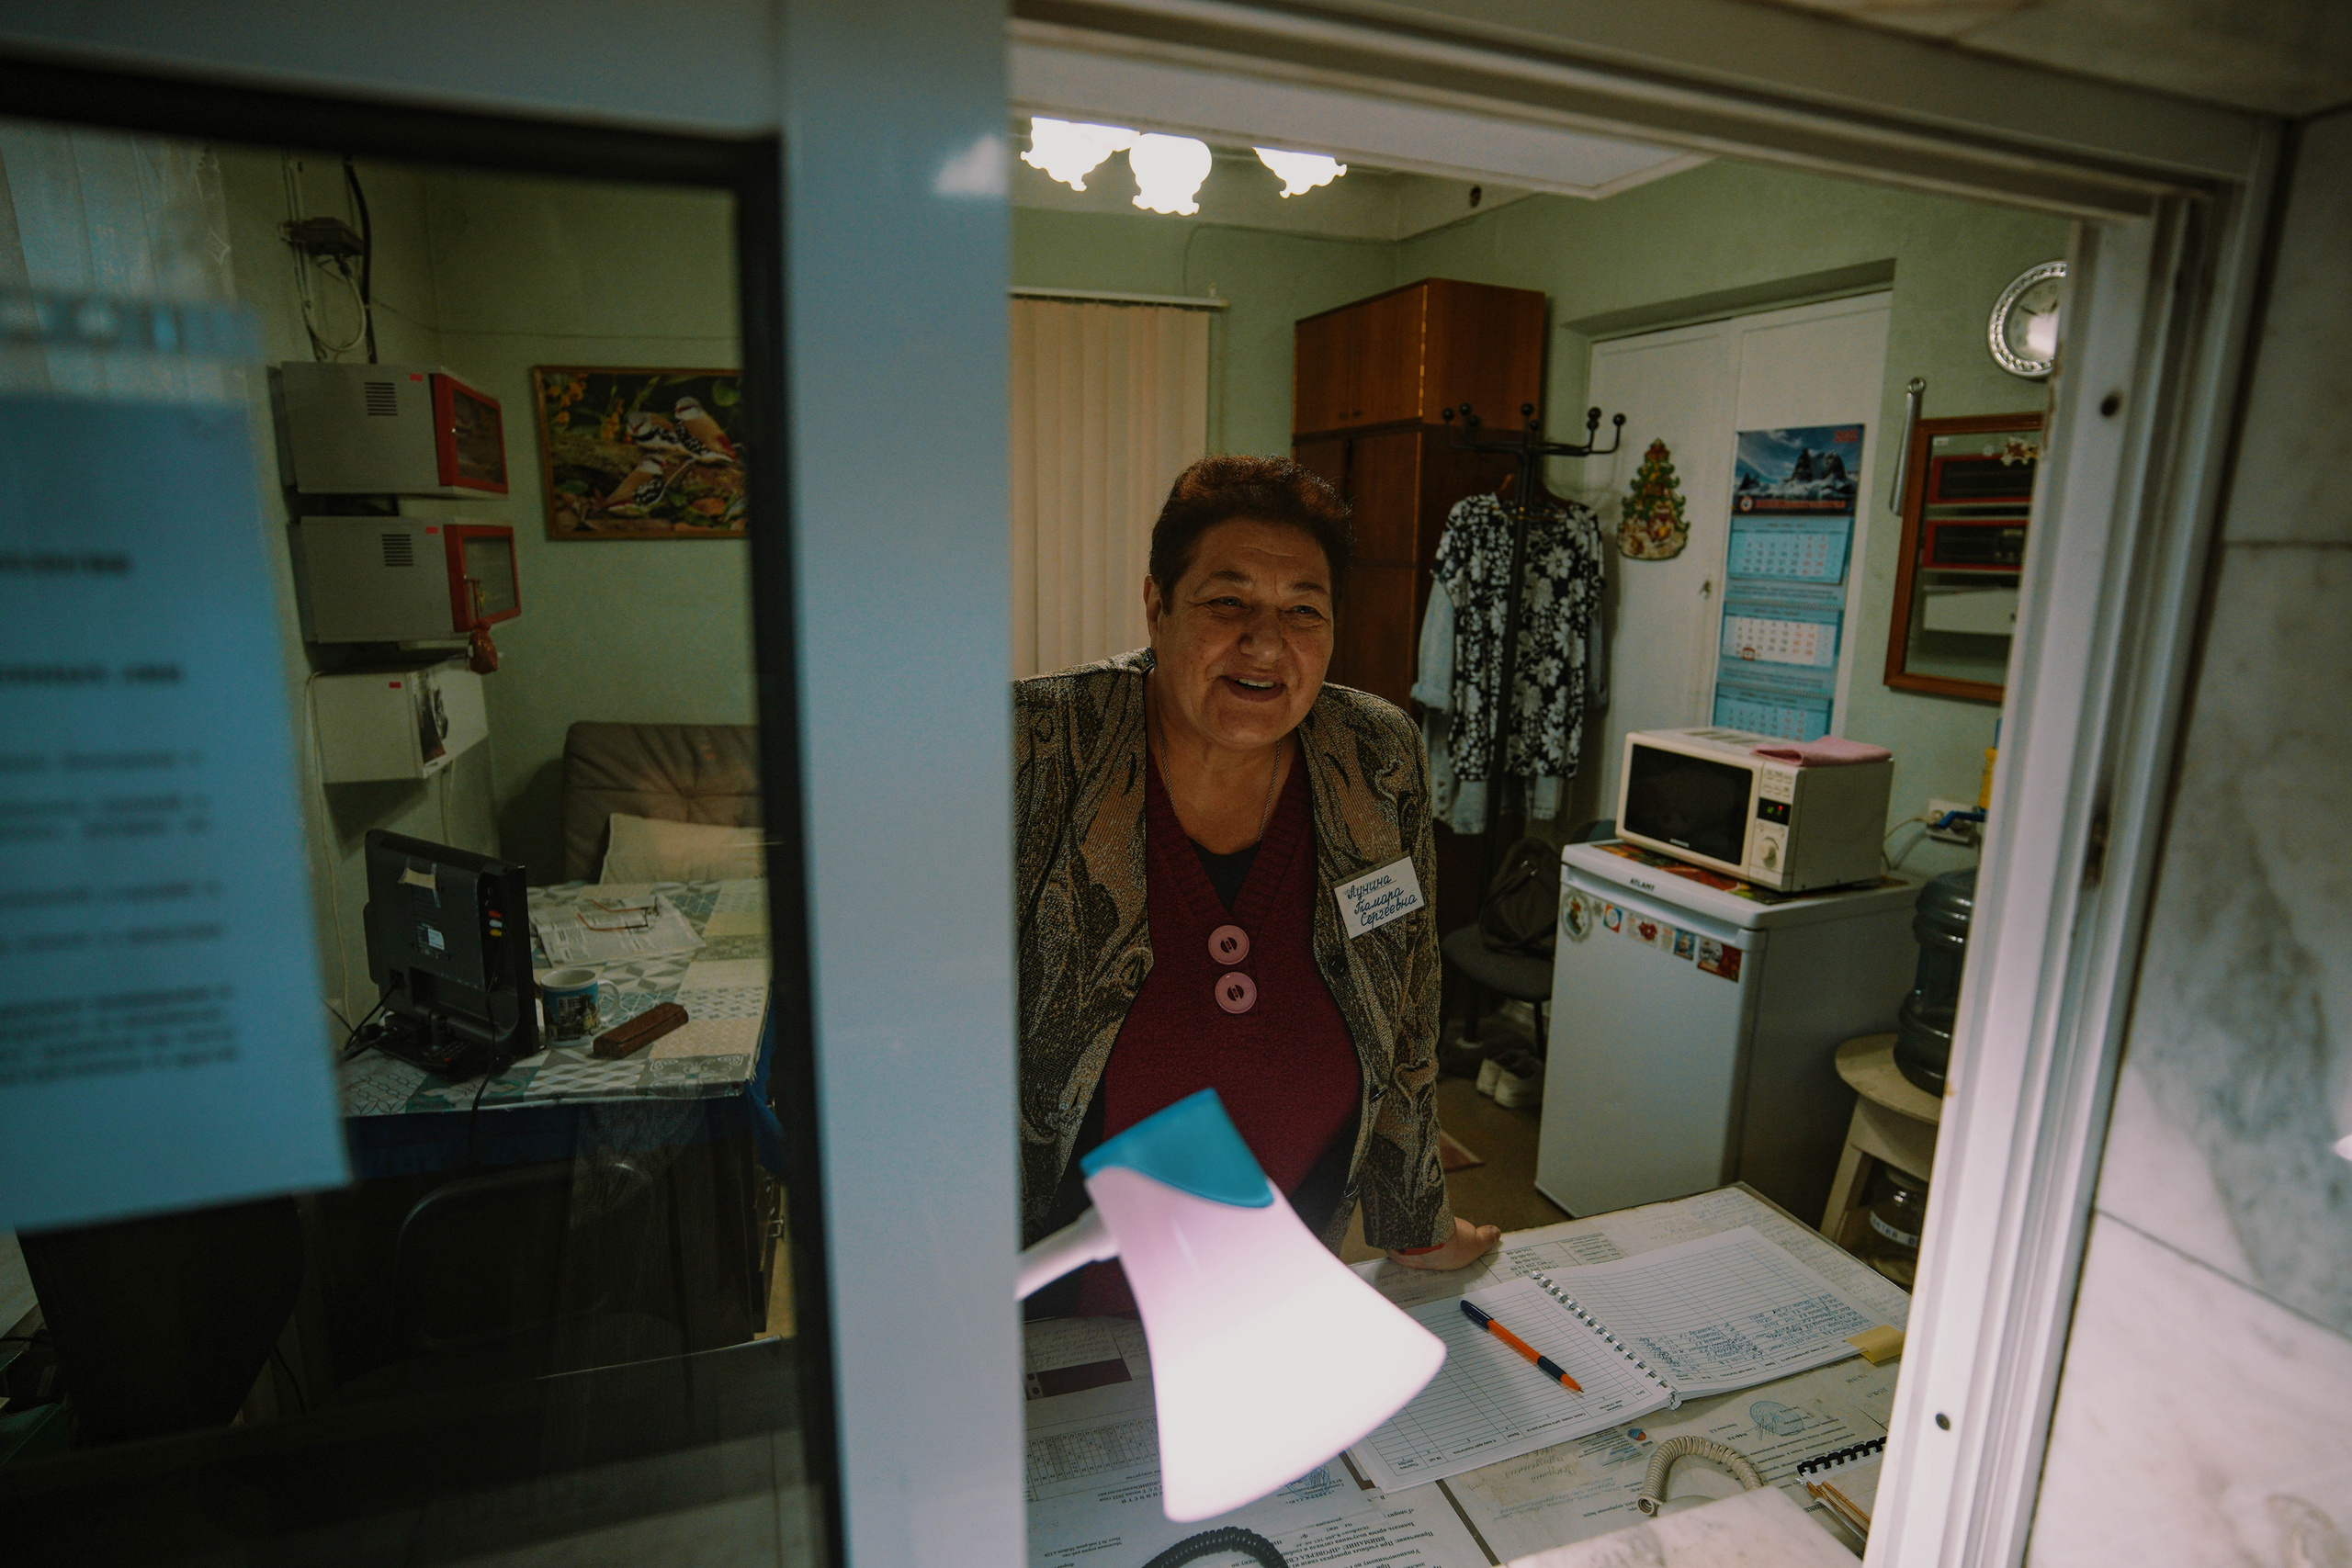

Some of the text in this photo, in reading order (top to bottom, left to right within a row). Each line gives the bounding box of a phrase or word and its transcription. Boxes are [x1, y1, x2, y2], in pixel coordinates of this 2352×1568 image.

[1347, 874, 1392, 900] Лунина
[1354, 887, 1404, 915] Тамара
[1360, 894, 1418, 929] Сергеевна
[1385, 1506, 1414, 1517] «Говорит
[1367, 1526, 1386, 1536] время
[1386, 1520, 1415, 1531] Записать
[1333, 1531, 1367, 1543] получения
[1340, 1535, 1385, 1550] ВНИМАНИЕ!
[1378, 1538, 1394, 1548] При
[1393, 1529, 1433, 1544] Примечание:
[1307, 1540, 1333, 1549] сигнала
[1351, 1541, 1379, 1554] учебных
[1298, 1545, 1341, 1561] «ПРОВЕРКА
[1318, 1549, 1351, 1562] проверках
[1362, 1548, 1419, 1566] Уполномоченному
